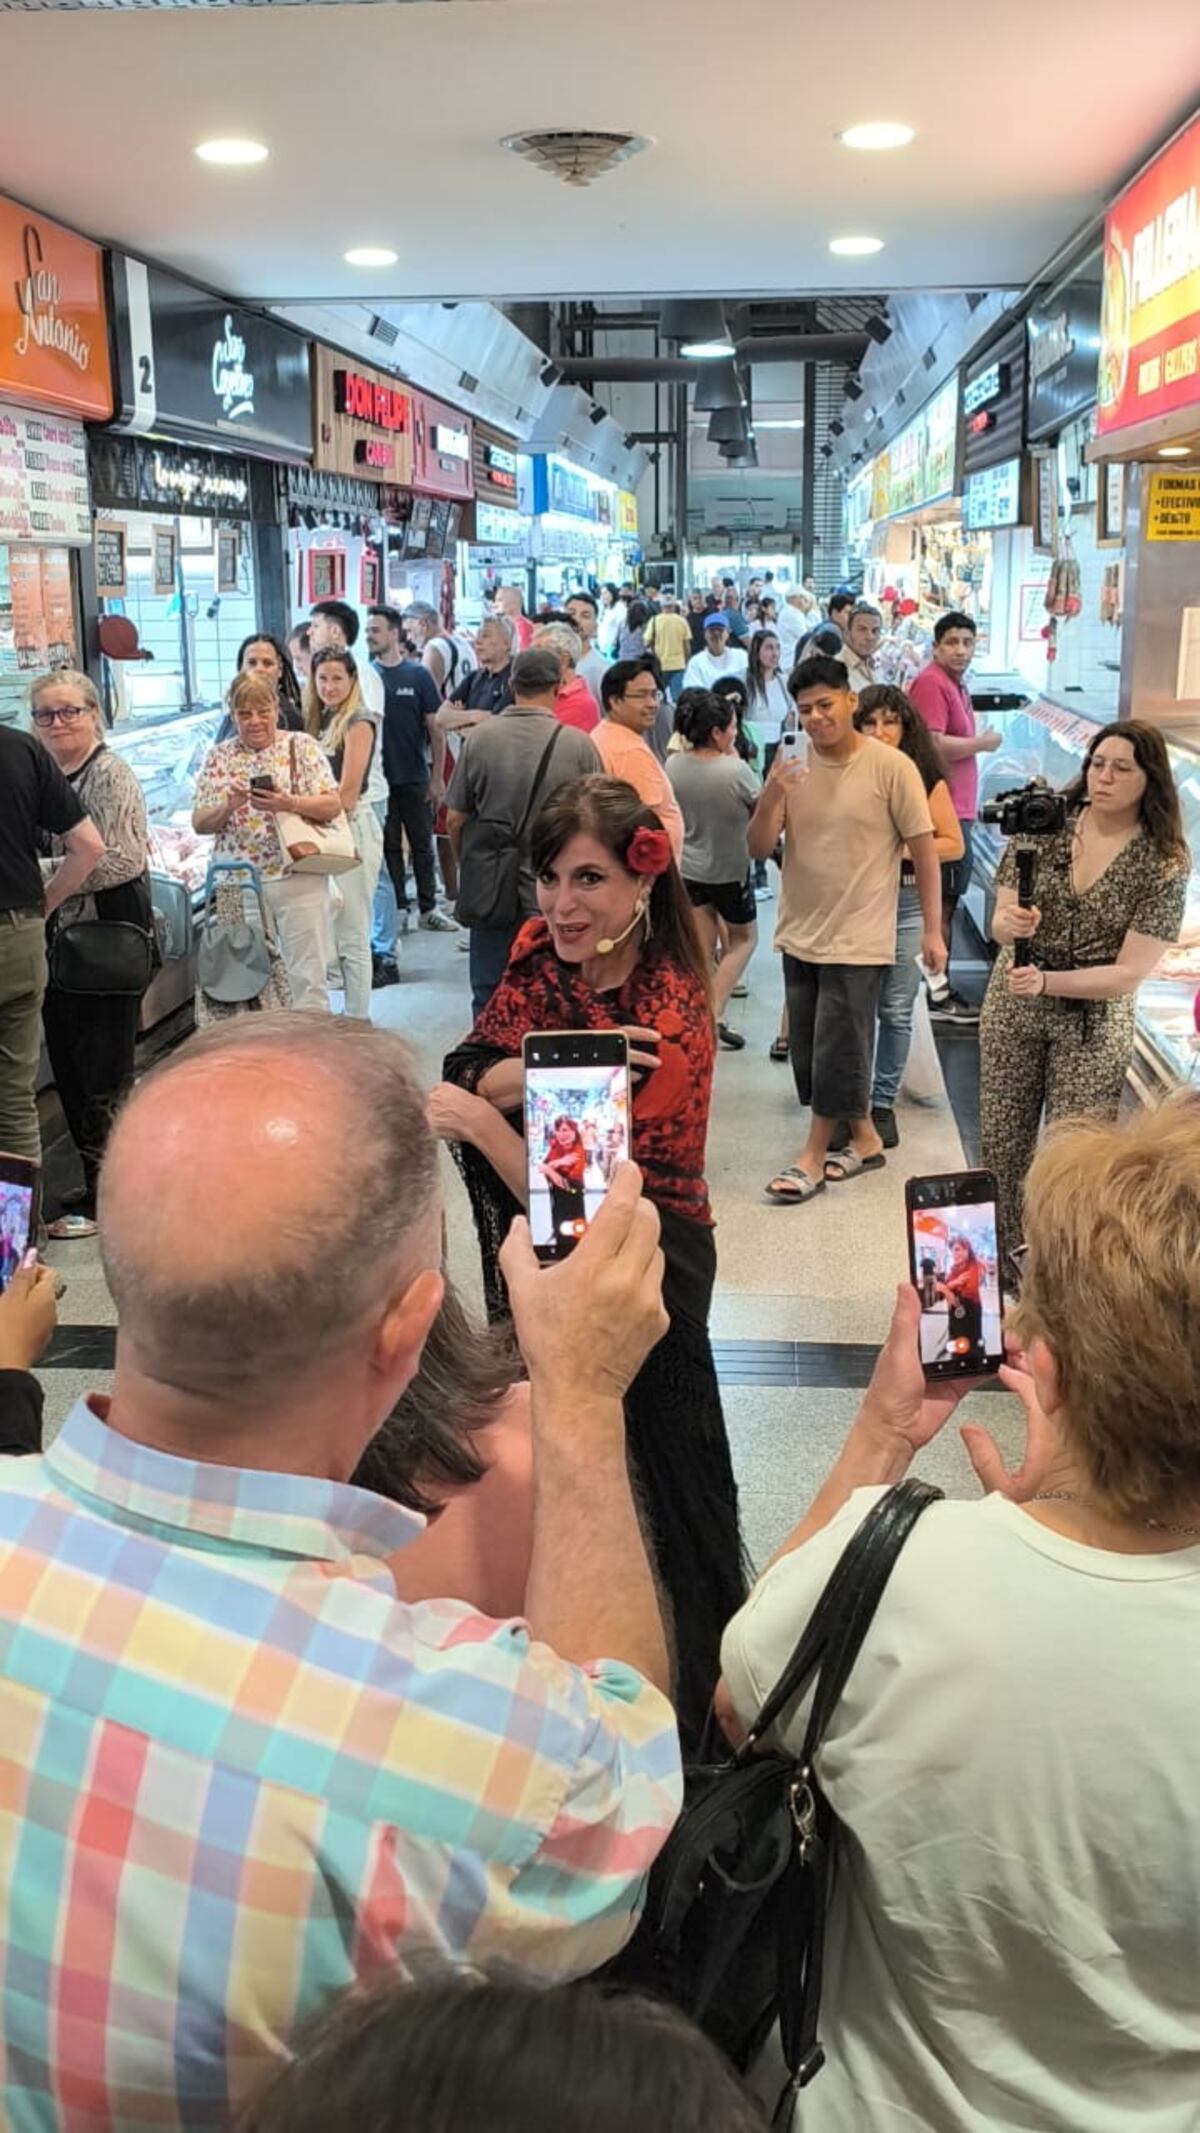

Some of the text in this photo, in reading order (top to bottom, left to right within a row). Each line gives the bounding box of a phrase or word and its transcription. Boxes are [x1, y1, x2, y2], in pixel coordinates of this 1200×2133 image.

[15, 224, 60, 315] San
[15, 277, 90, 370] Antonio
[138, 355, 153, 394] 2
[345, 371, 373, 421] DON
